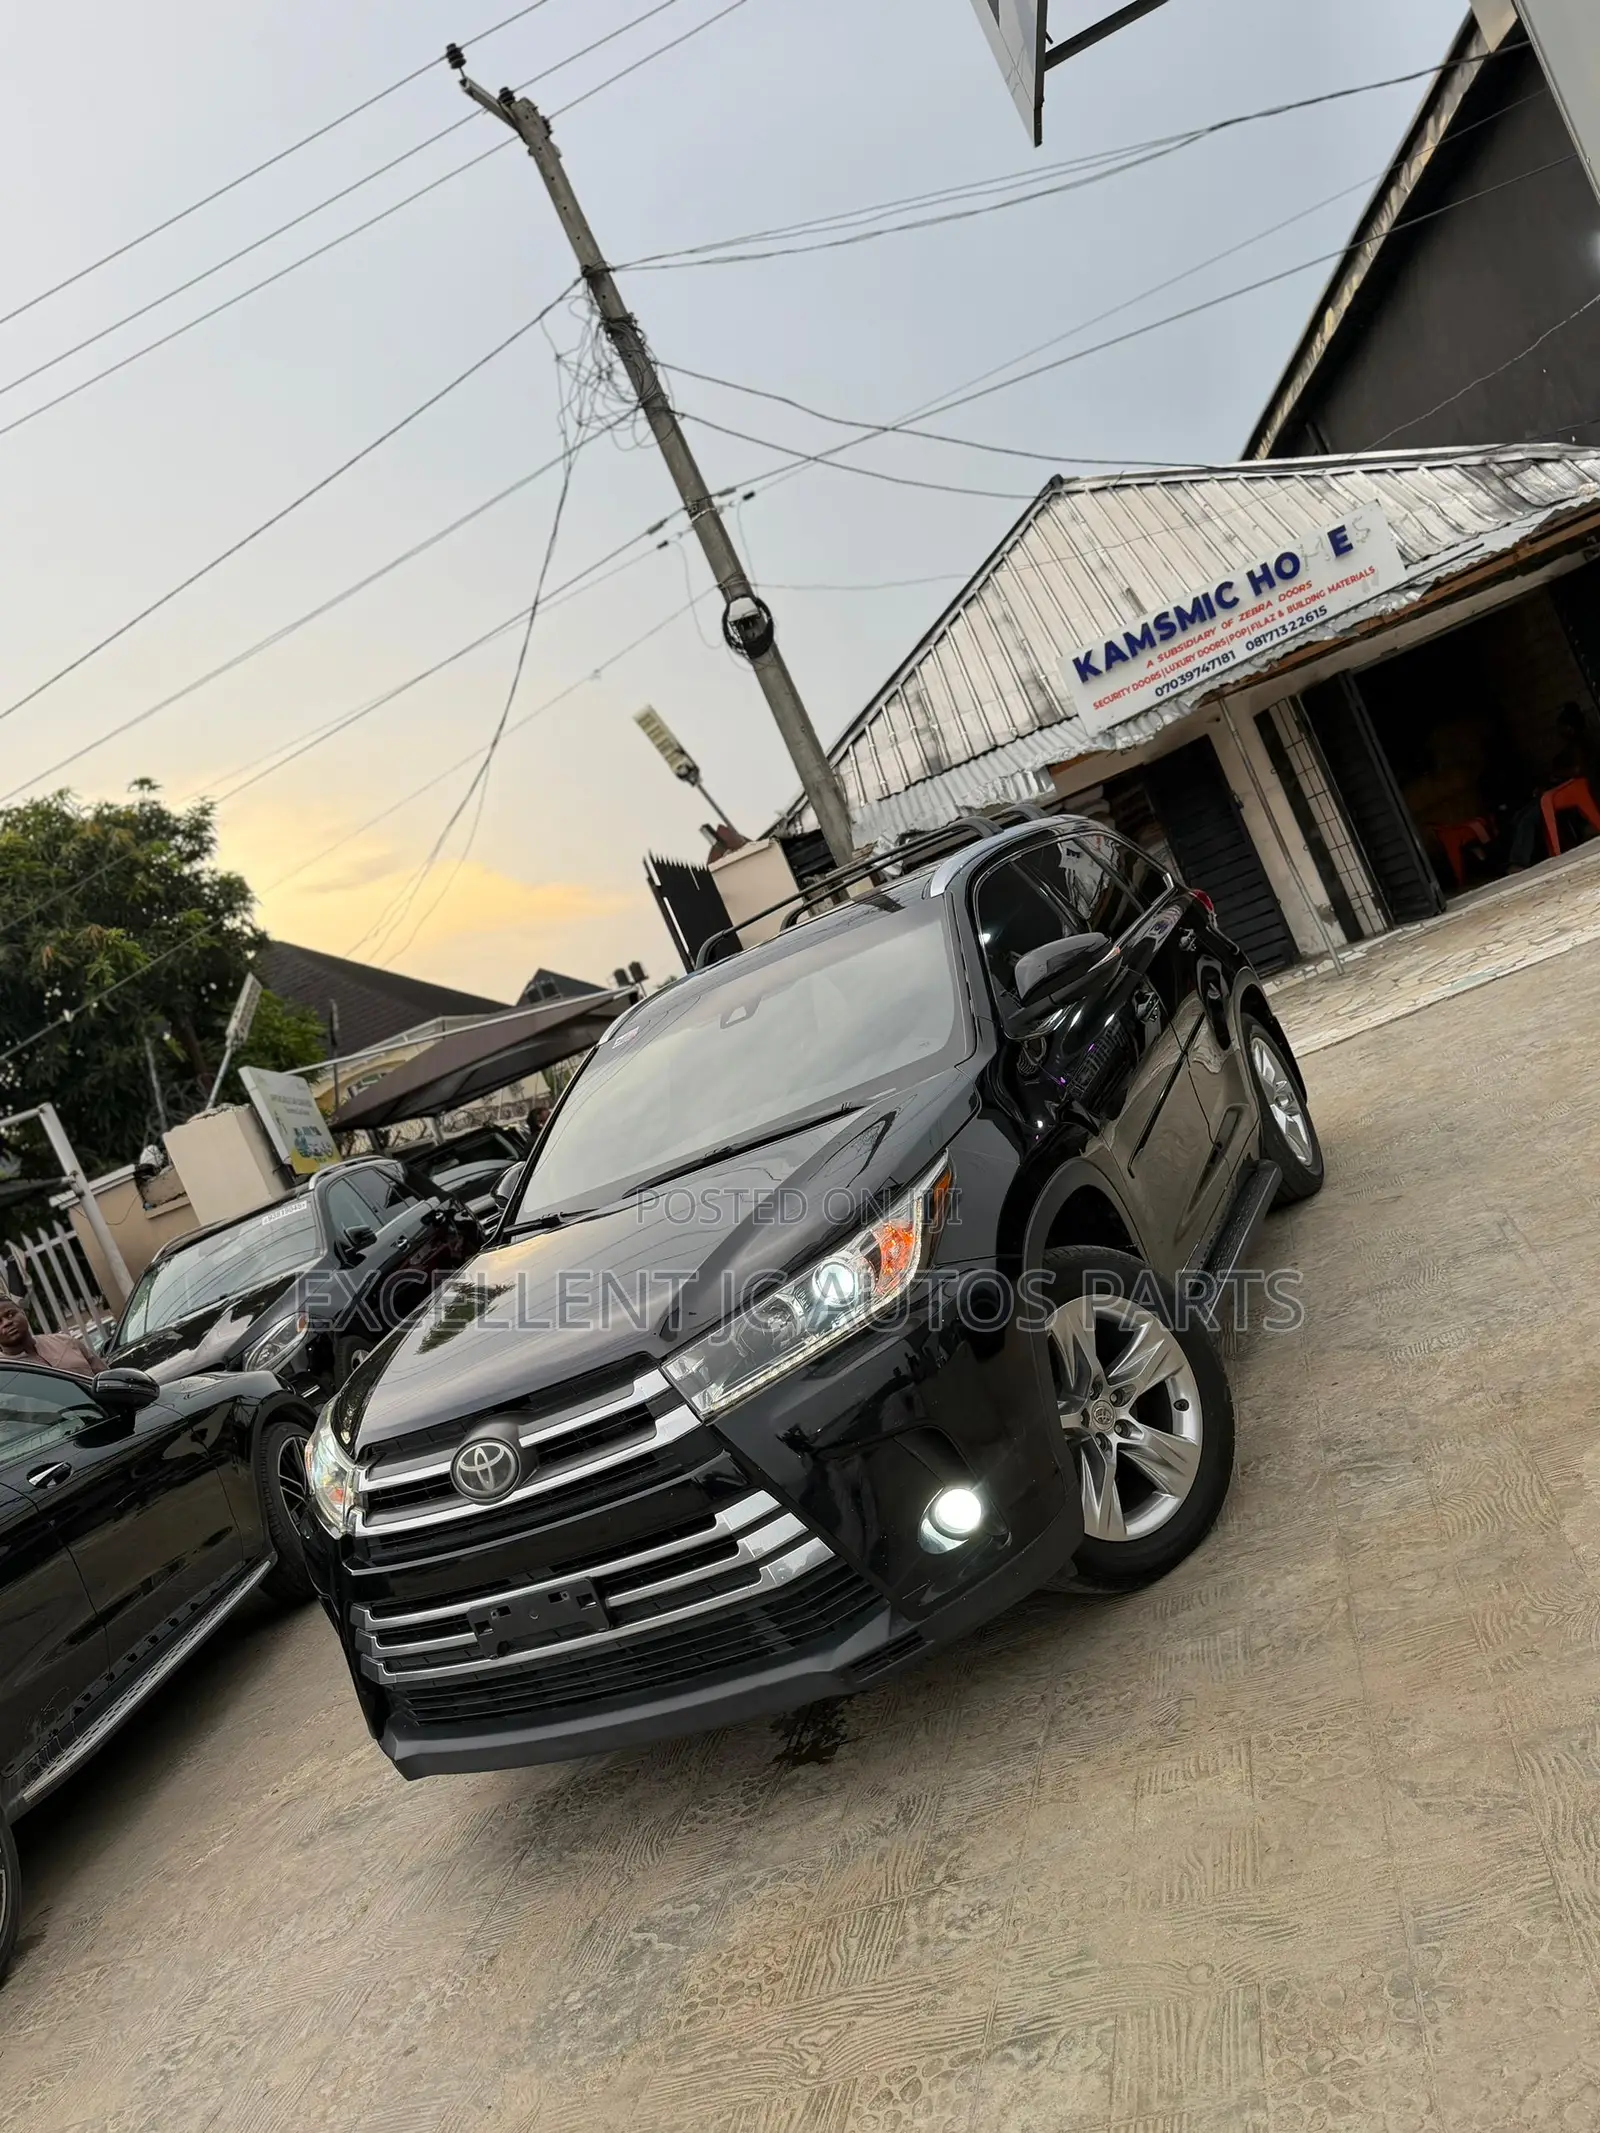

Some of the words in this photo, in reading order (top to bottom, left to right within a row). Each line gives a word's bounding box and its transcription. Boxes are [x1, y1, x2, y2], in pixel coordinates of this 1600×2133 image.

[1072, 581, 1240, 684] KAMSMIC
[1093, 687, 1131, 711] SECURITY
[1278, 610, 1285, 618] &
[1286, 590, 1326, 614] BUILDING
[1328, 565, 1376, 595] MATERIALS
[1146, 660, 1155, 669] A
[1157, 627, 1217, 663] SUBSIDIARY
[1221, 618, 1234, 631] OF
[1239, 600, 1273, 622] ZEBRA
[1278, 580, 1313, 603] DOORS
[1155, 650, 1237, 697] 07039747181
[1245, 605, 1328, 652] 08171322615
